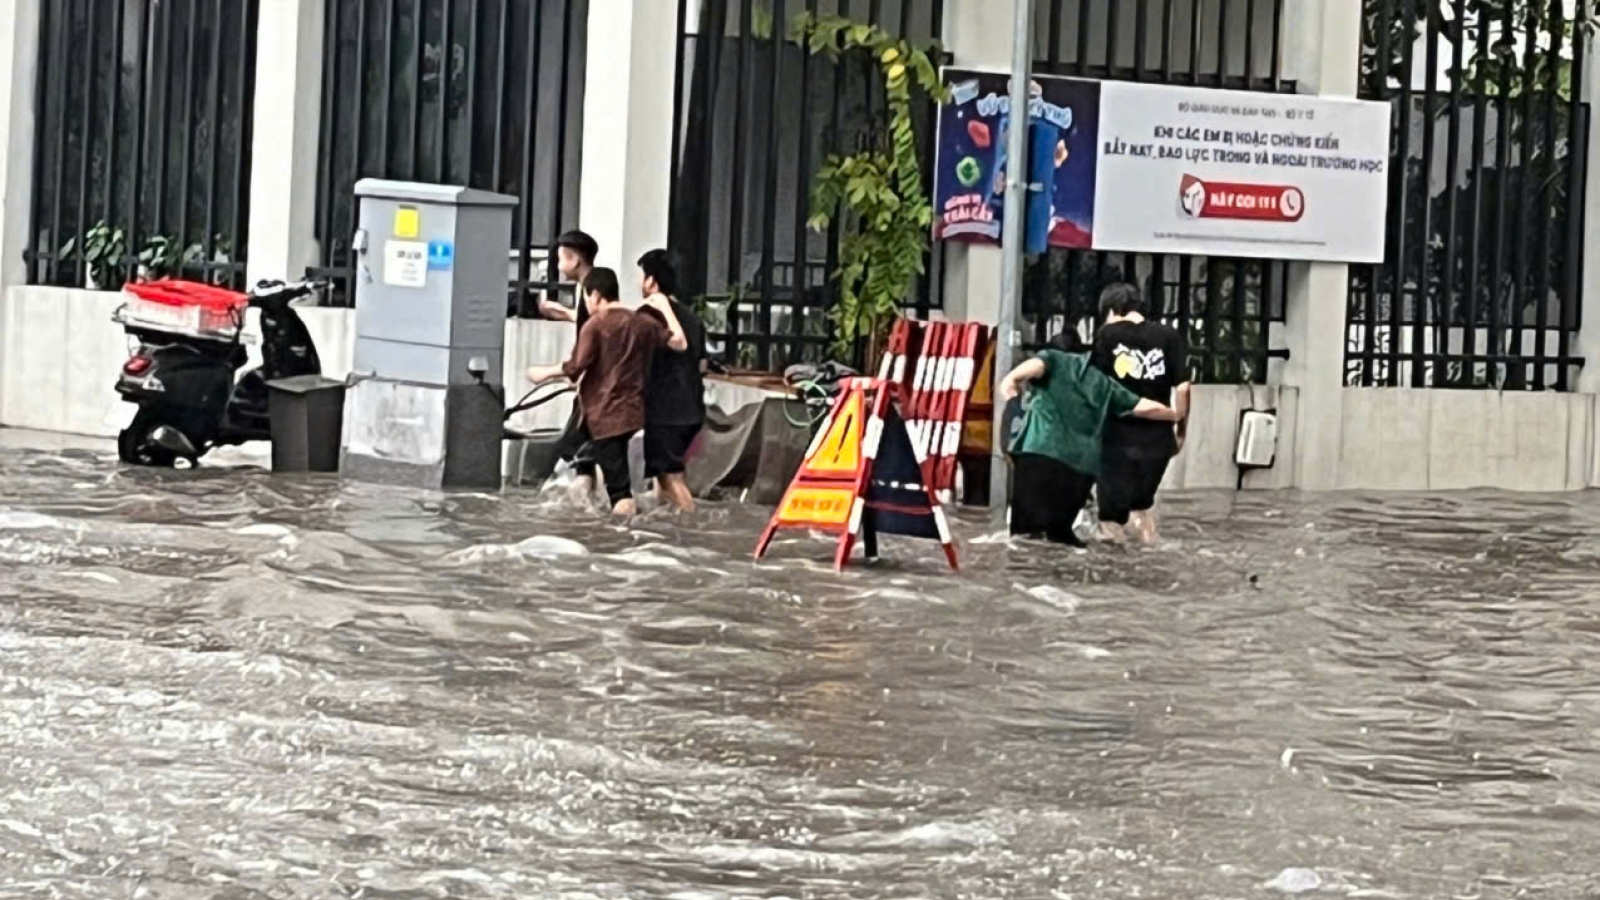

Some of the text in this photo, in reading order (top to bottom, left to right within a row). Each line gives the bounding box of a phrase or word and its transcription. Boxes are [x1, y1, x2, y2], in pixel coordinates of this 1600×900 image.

[1176, 126, 1200, 141] CÁC
[1203, 129, 1220, 142] EM
[1213, 149, 1251, 164] TRONG
[1254, 150, 1269, 165] VÀ
[1359, 158, 1383, 173] HỌC
